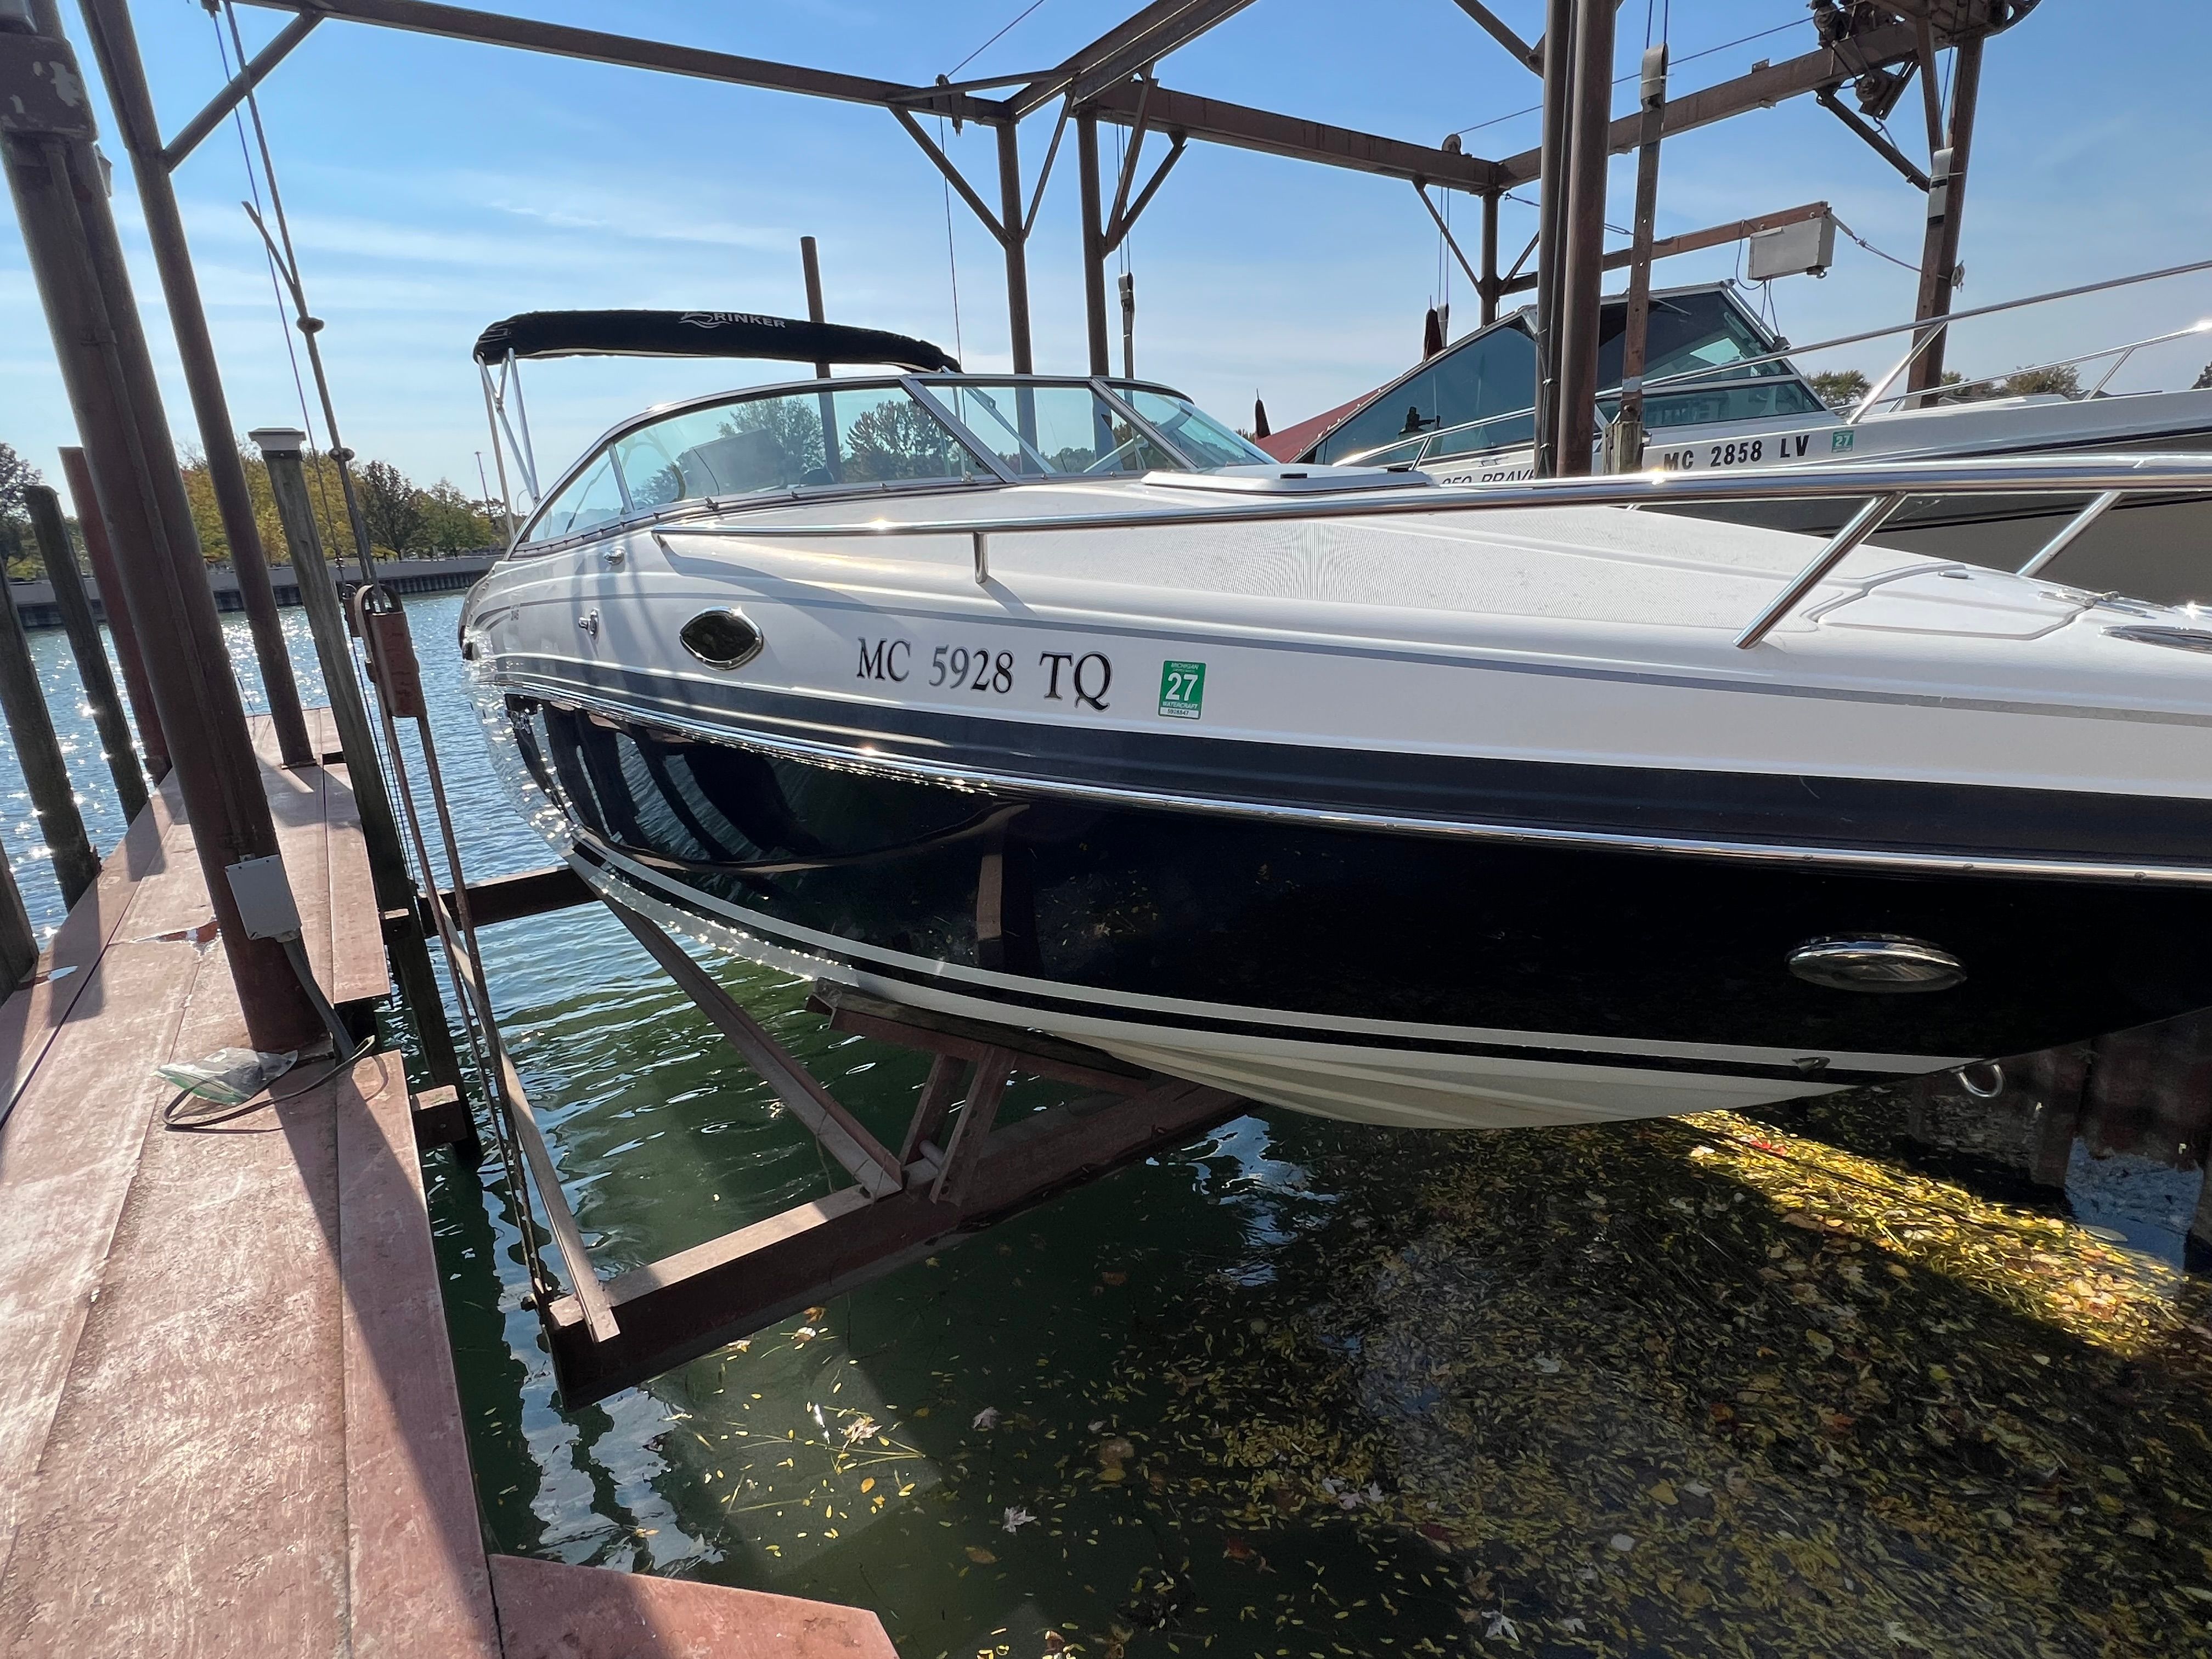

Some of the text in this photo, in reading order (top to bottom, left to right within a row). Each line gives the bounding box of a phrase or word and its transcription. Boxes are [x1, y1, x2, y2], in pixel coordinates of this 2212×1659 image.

[714, 313, 786, 328] RINKER
[1663, 435, 1810, 471] MC 2858 LV
[1836, 435, 1850, 447] 27
[857, 636, 1113, 712] MC 5928 TQ
[1166, 673, 1198, 701] 27
